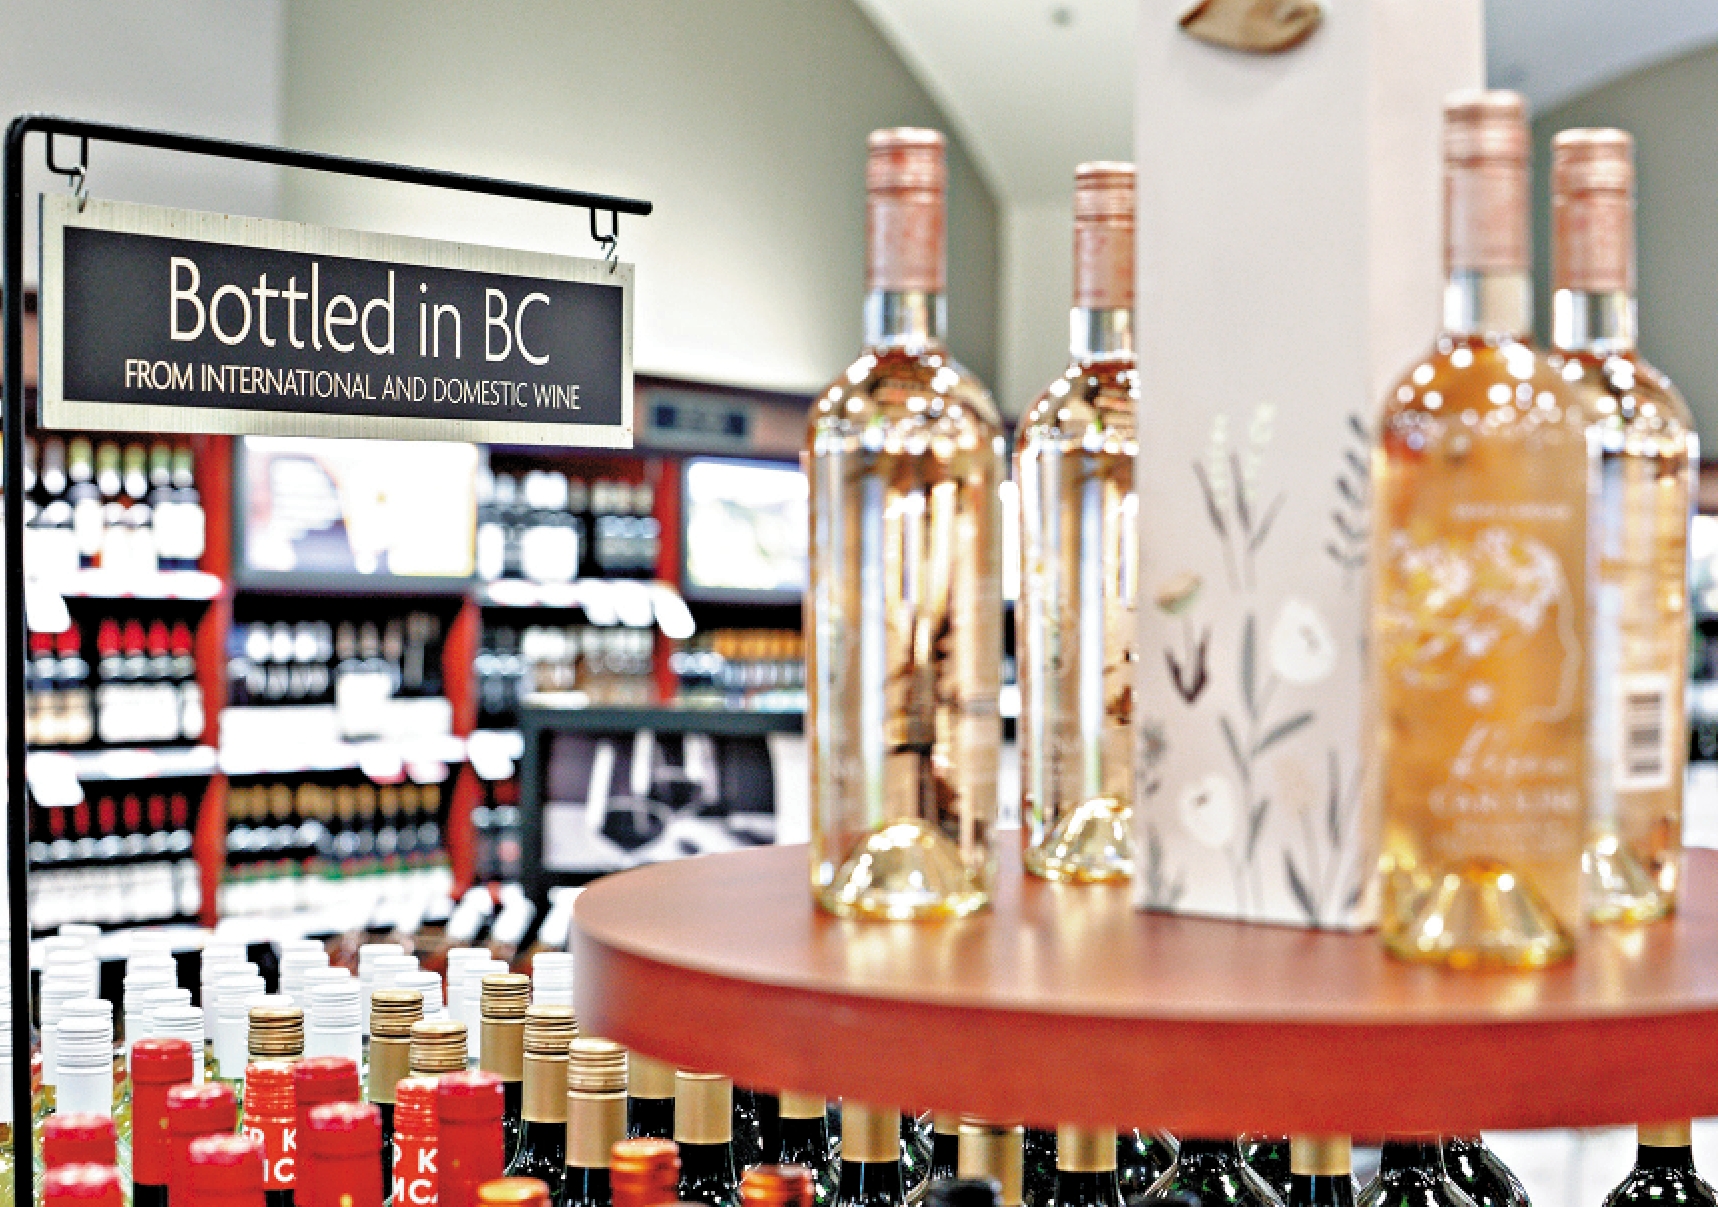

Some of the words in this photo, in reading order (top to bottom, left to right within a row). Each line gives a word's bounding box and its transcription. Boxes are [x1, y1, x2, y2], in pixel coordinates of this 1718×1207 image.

[171, 257, 395, 356] Bottled
[420, 283, 461, 360] in
[485, 288, 550, 366] BC
[125, 359, 194, 393] FROM
[201, 365, 377, 402] INTERNATIONAL
[382, 375, 428, 402] AND
[433, 377, 528, 409] DOMESTIC
[533, 383, 581, 411] WINE
